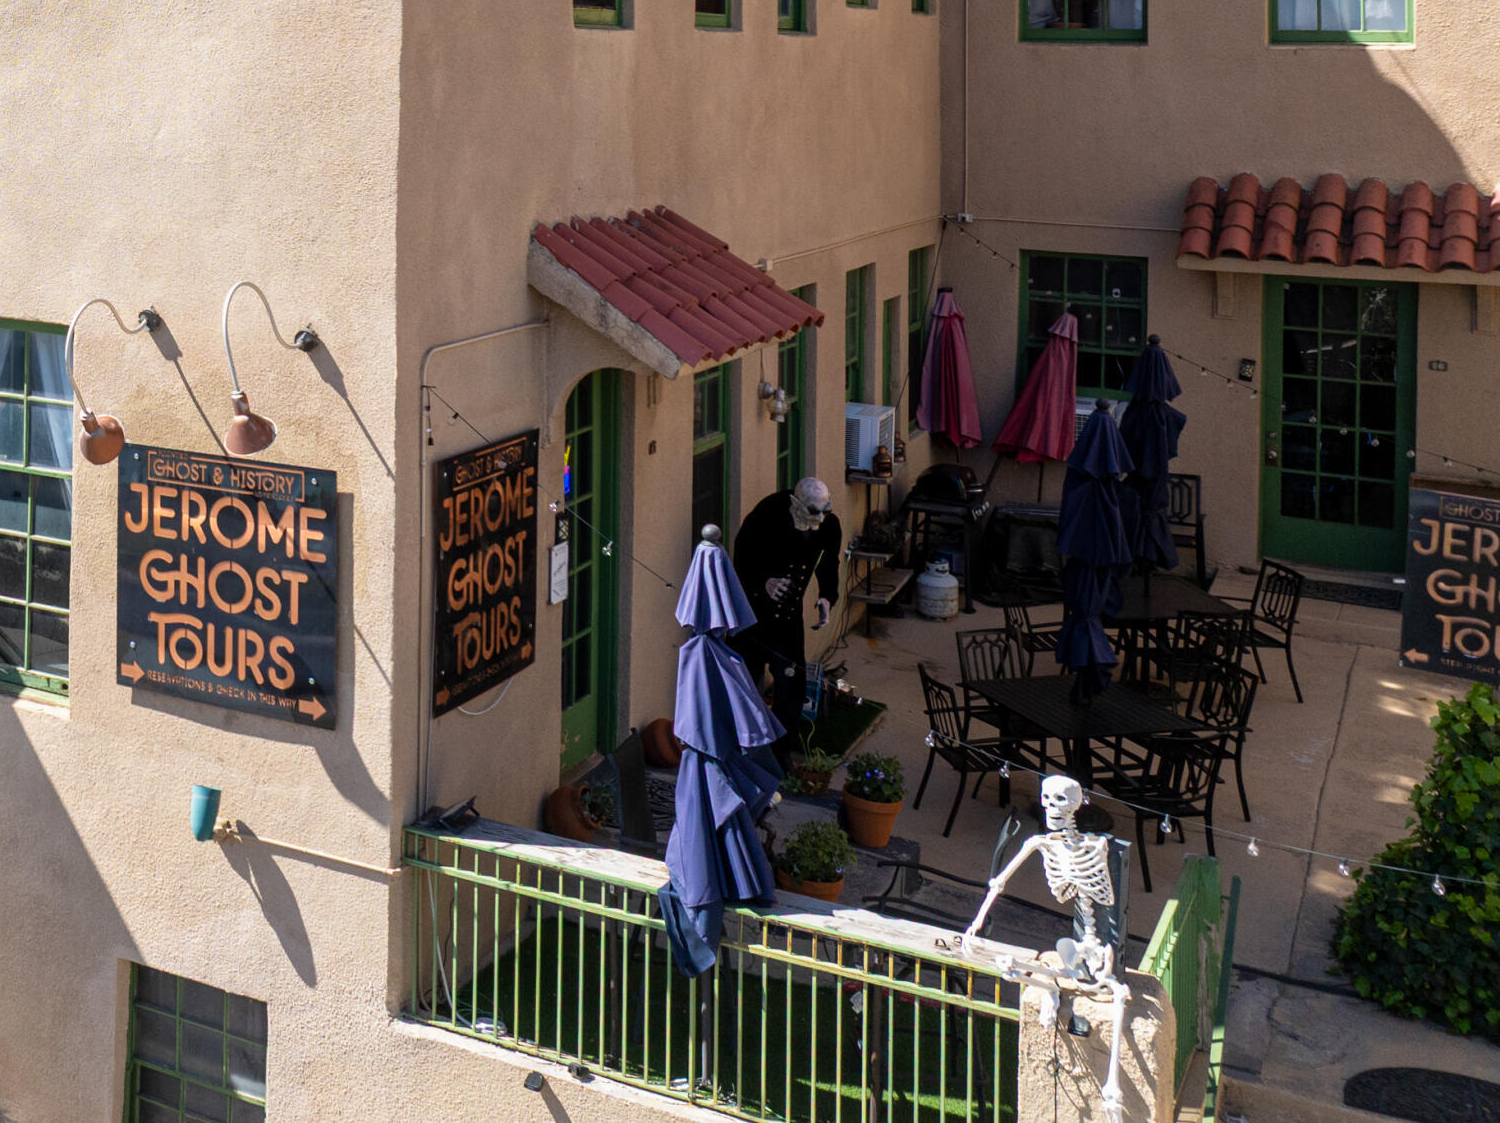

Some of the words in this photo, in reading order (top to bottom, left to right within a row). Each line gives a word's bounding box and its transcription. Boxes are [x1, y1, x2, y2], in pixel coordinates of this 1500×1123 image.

[152, 458, 207, 483] GHOST
[213, 466, 224, 485] &
[230, 467, 295, 494] HISTORY
[440, 466, 535, 552] JEROME
[1444, 502, 1500, 522] GHOST
[124, 482, 327, 563] JEROME
[1412, 517, 1500, 567] JER
[139, 549, 308, 625] GHOST
[448, 530, 527, 611] GHOST
[1426, 568, 1500, 613] GH
[148, 611, 295, 691] TOURS
[453, 596, 522, 675] TOURS
